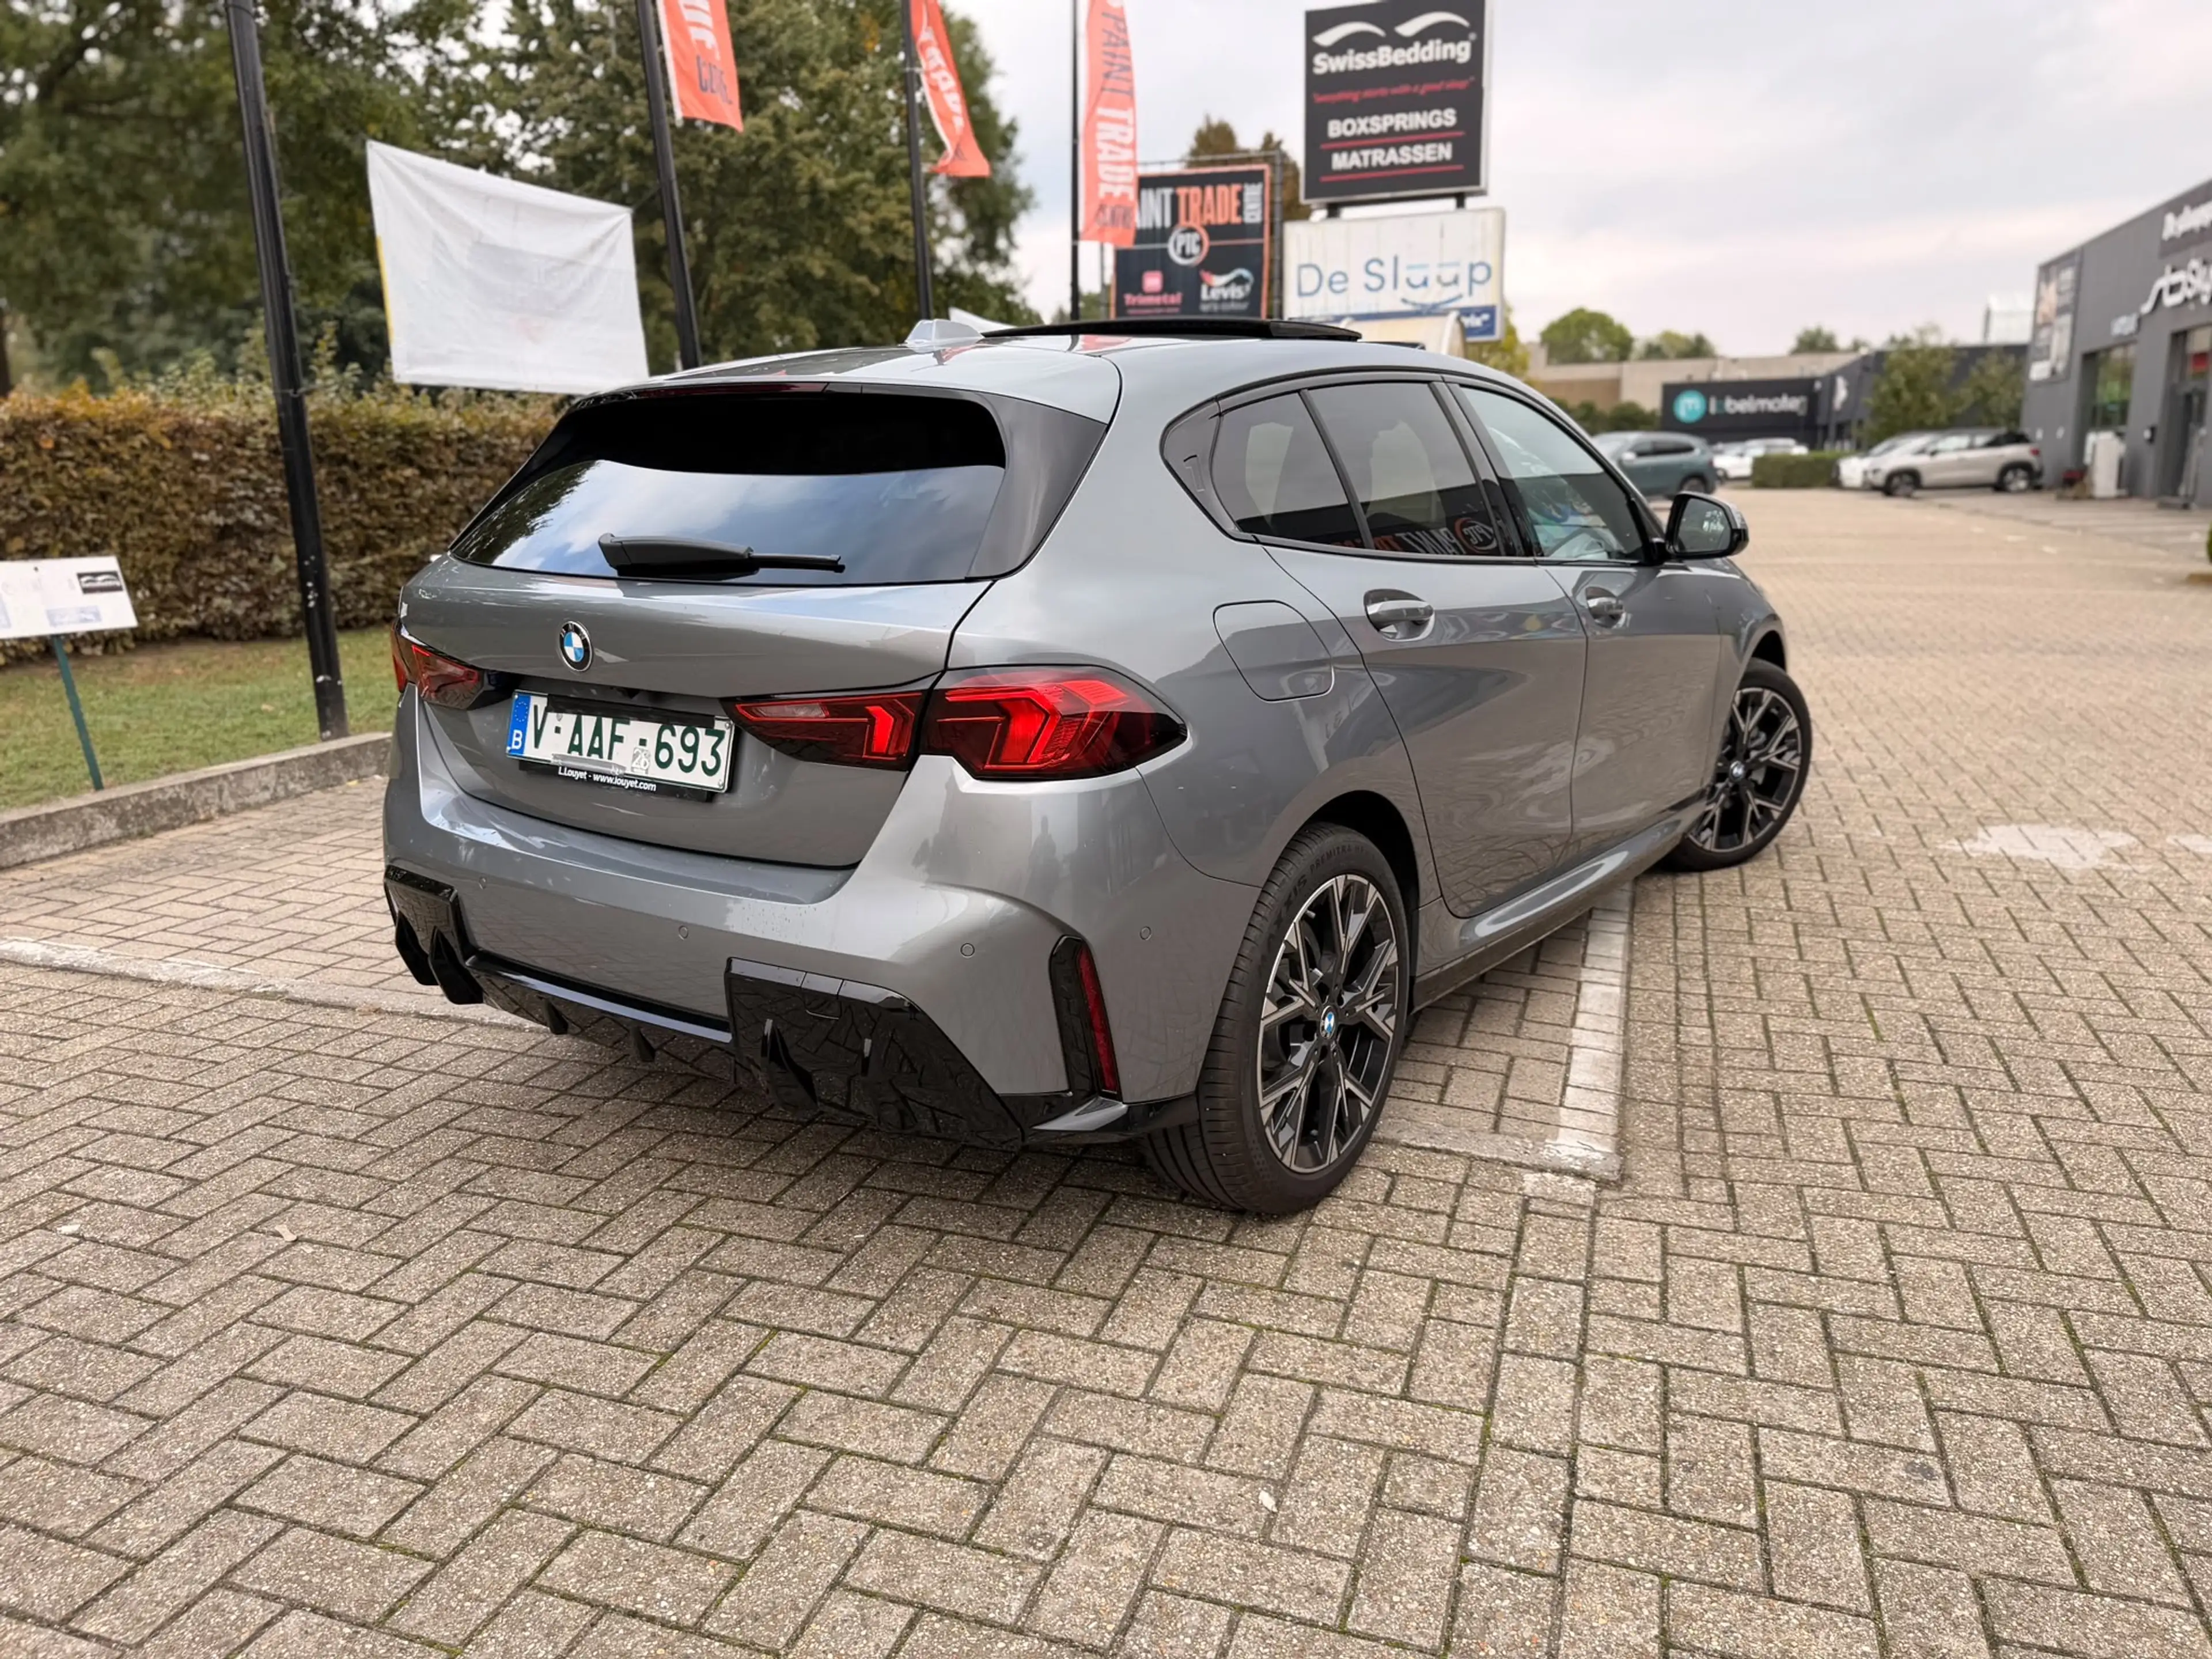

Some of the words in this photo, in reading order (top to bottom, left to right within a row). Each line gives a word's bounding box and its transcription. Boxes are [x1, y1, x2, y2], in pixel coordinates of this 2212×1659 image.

[1101, 12, 1134, 99] PAINT
[1328, 108, 1456, 138] BOXSPRINGS
[1096, 107, 1135, 201] TRADE
[1332, 142, 1453, 171] MATRASSEN
[1176, 183, 1242, 227] TRADE
[1297, 263, 1349, 297] De
[512, 729, 523, 750] B
